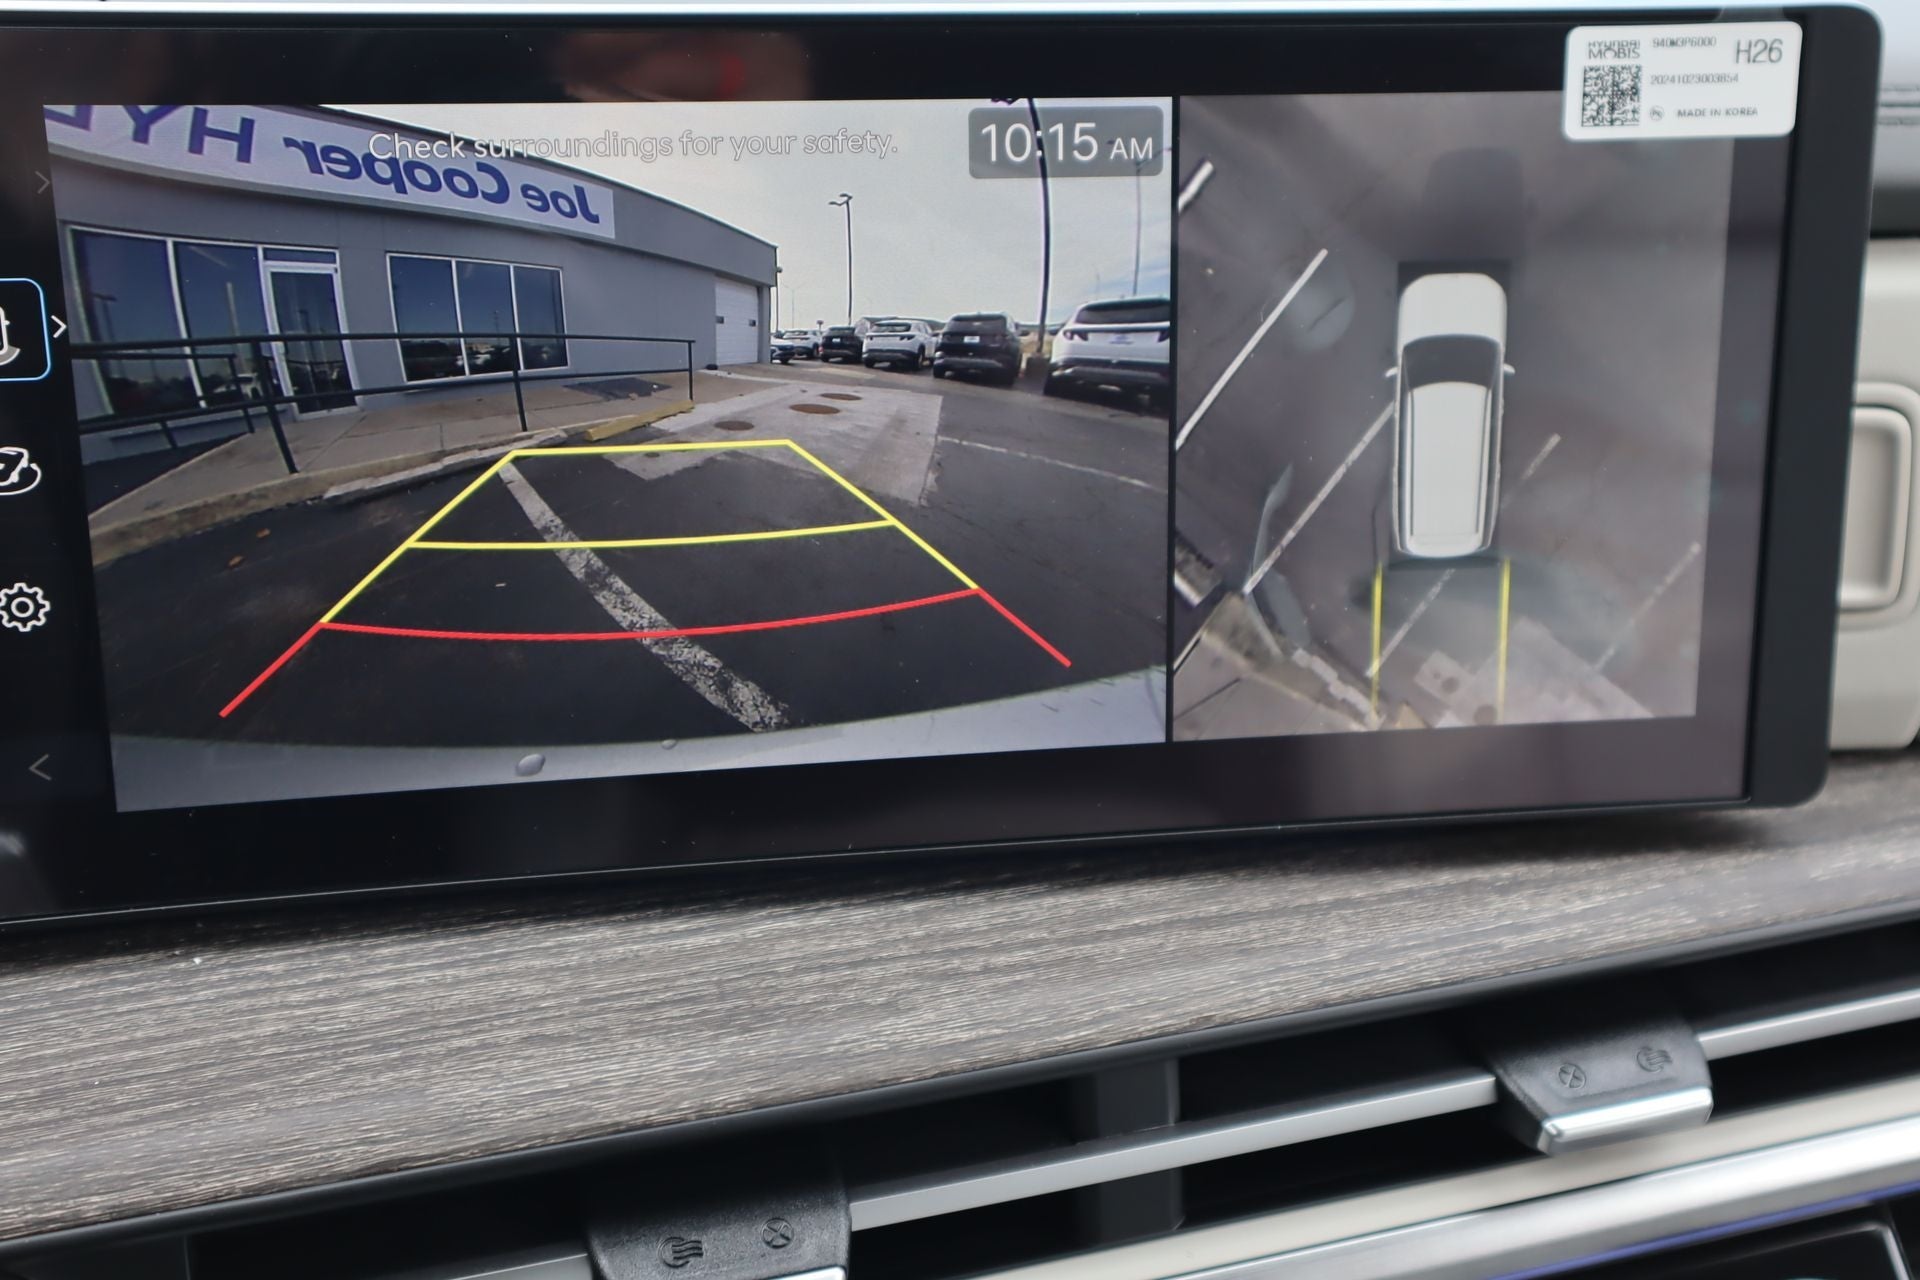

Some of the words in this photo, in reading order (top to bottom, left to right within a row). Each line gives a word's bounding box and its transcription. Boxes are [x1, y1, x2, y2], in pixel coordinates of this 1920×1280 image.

[1588, 47, 1640, 59] MOBIS
[1735, 38, 1783, 64] H26
[1677, 109, 1707, 117] MADE
[1710, 108, 1721, 117] IN
[1725, 107, 1758, 116] KOREA
[368, 131, 466, 160] Check
[474, 129, 673, 163] surroundings
[679, 129, 724, 156] for
[730, 134, 797, 161] your
[803, 127, 898, 159] safety.
[981, 122, 1098, 162] 10:15
[1110, 137, 1153, 160] AM
